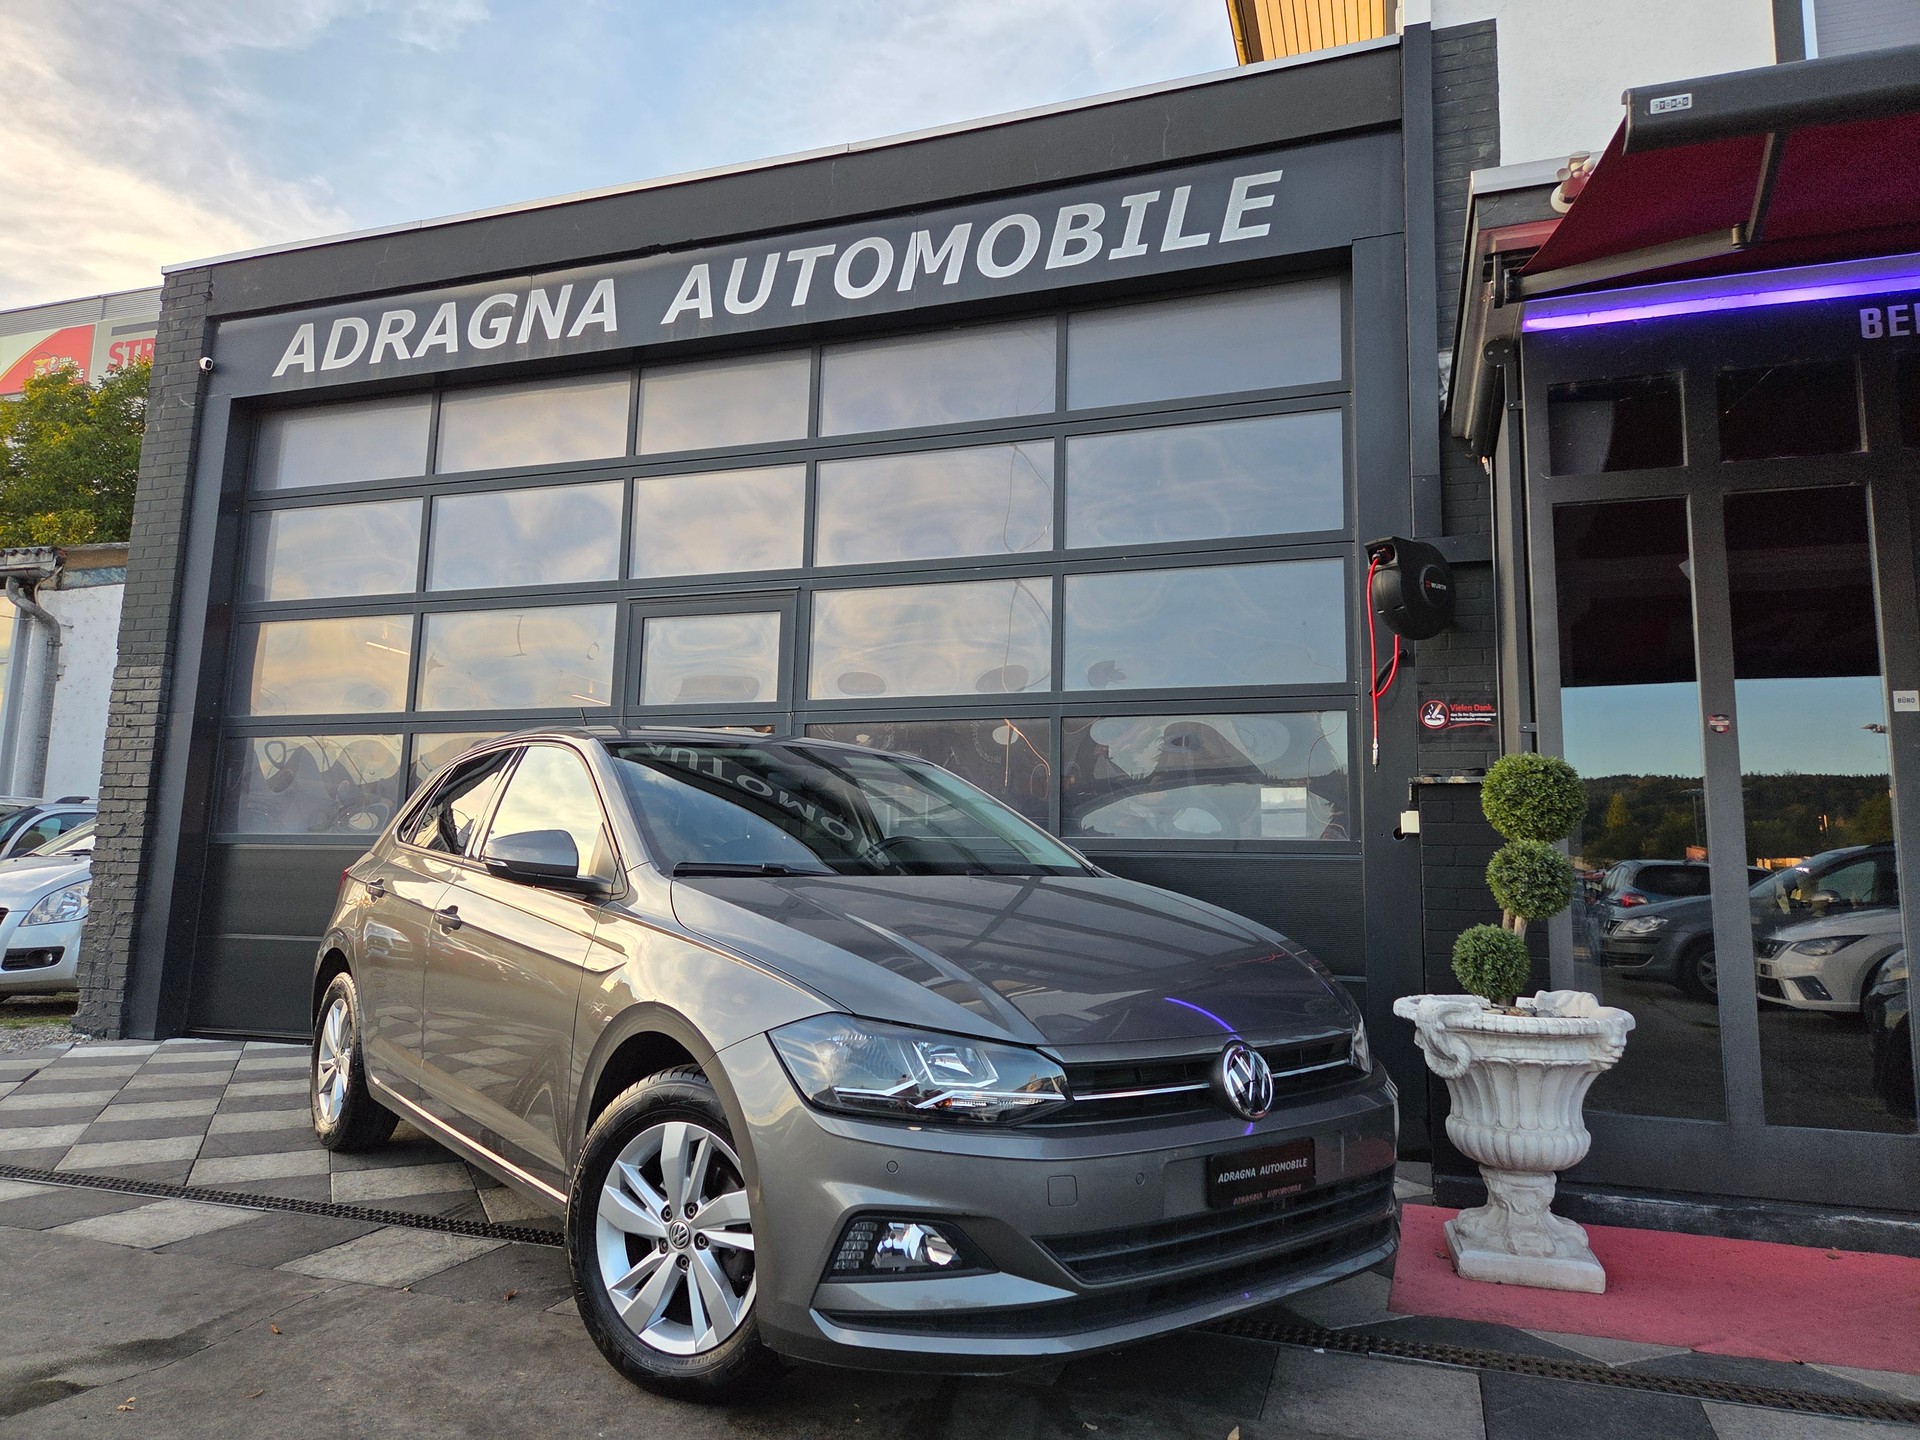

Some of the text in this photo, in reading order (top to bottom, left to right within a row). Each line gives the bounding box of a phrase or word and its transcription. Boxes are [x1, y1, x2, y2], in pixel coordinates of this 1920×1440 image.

[272, 170, 1284, 377] ADRAGNA AUTOMOBILE
[1218, 1158, 1308, 1184] ADRAGNA AUTOMOBILE
